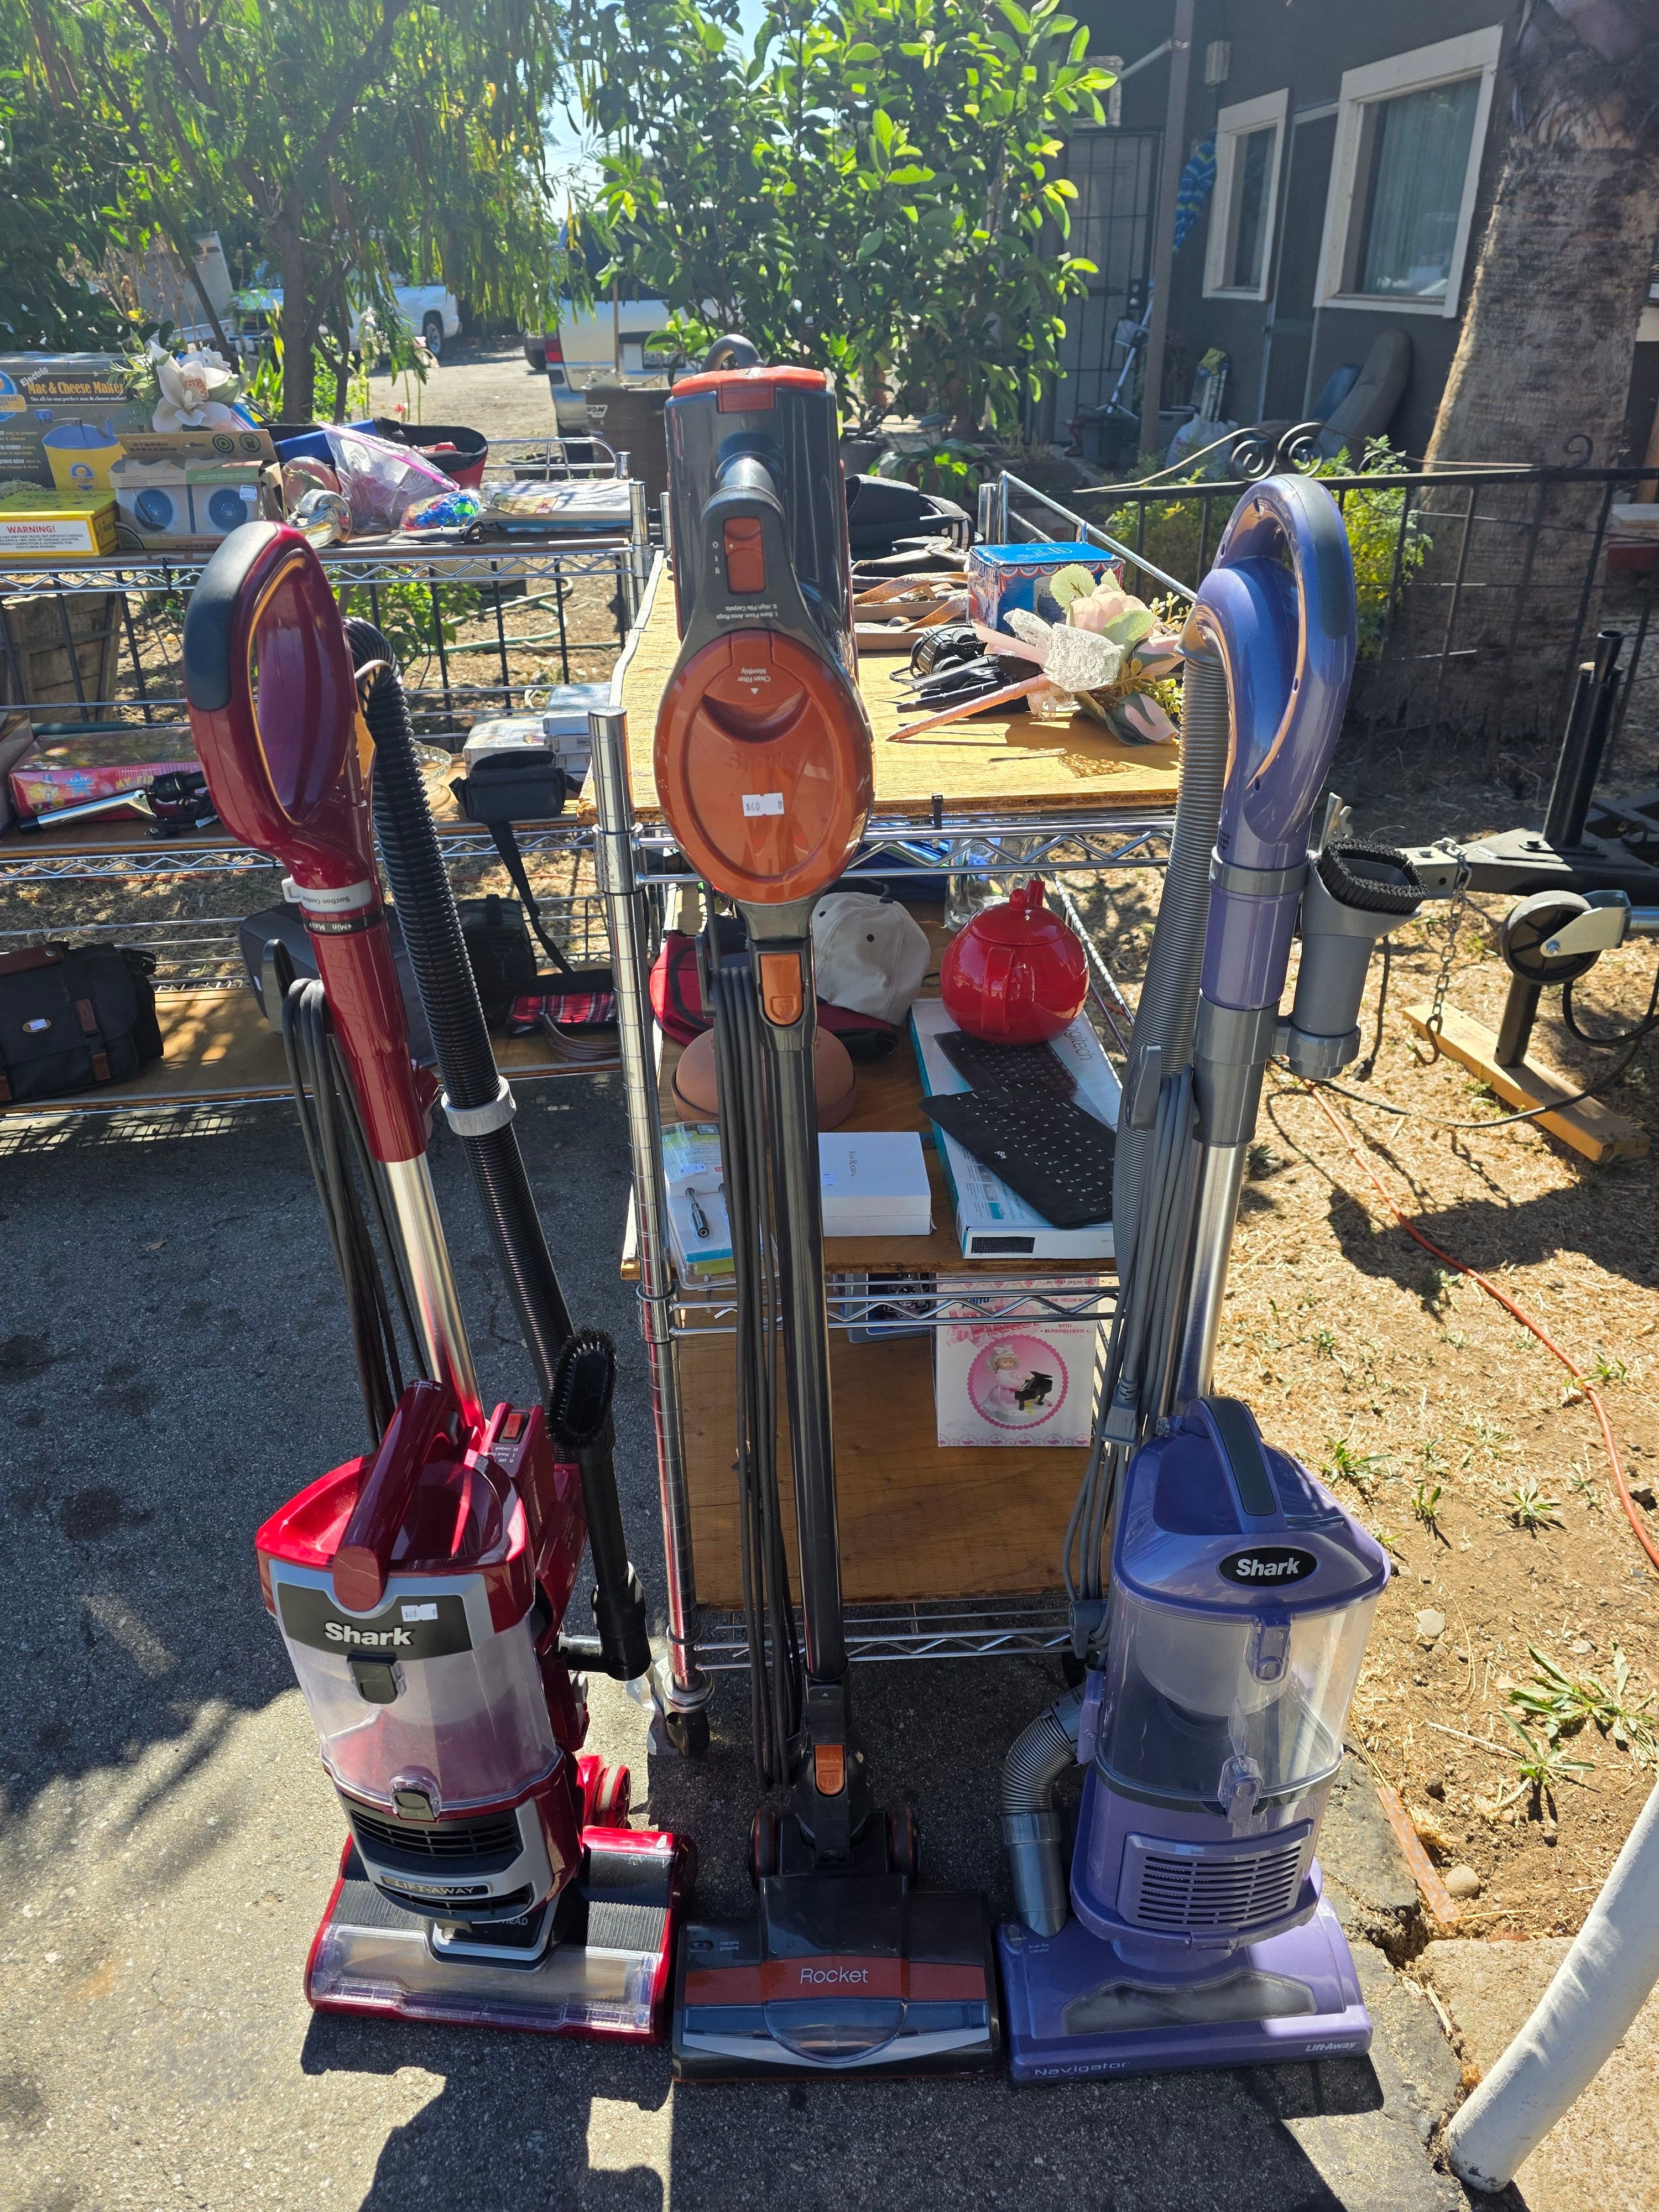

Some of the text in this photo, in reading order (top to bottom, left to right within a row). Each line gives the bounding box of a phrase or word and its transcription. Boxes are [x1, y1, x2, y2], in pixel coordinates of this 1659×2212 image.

[19, 366, 49, 387] Electric
[28, 382, 124, 394] Mac & Cheese Maker
[7, 525, 56, 534] WARNING!
[745, 802, 760, 812] $60
[322, 896, 351, 905] Suction
[312, 922, 348, 932] Min Max
[1064, 1020, 1096, 1061] ogitech
[848, 1151, 857, 1160] KIM
[994, 1151, 1008, 1159] logi
[1236, 1557, 1301, 1576] Shark
[324, 1620, 414, 1646] Shark
[394, 1880, 474, 1895] LIFT-AWAY
[800, 1966, 869, 1984] Rocket
[1035, 2062, 1127, 2075] Navigator
